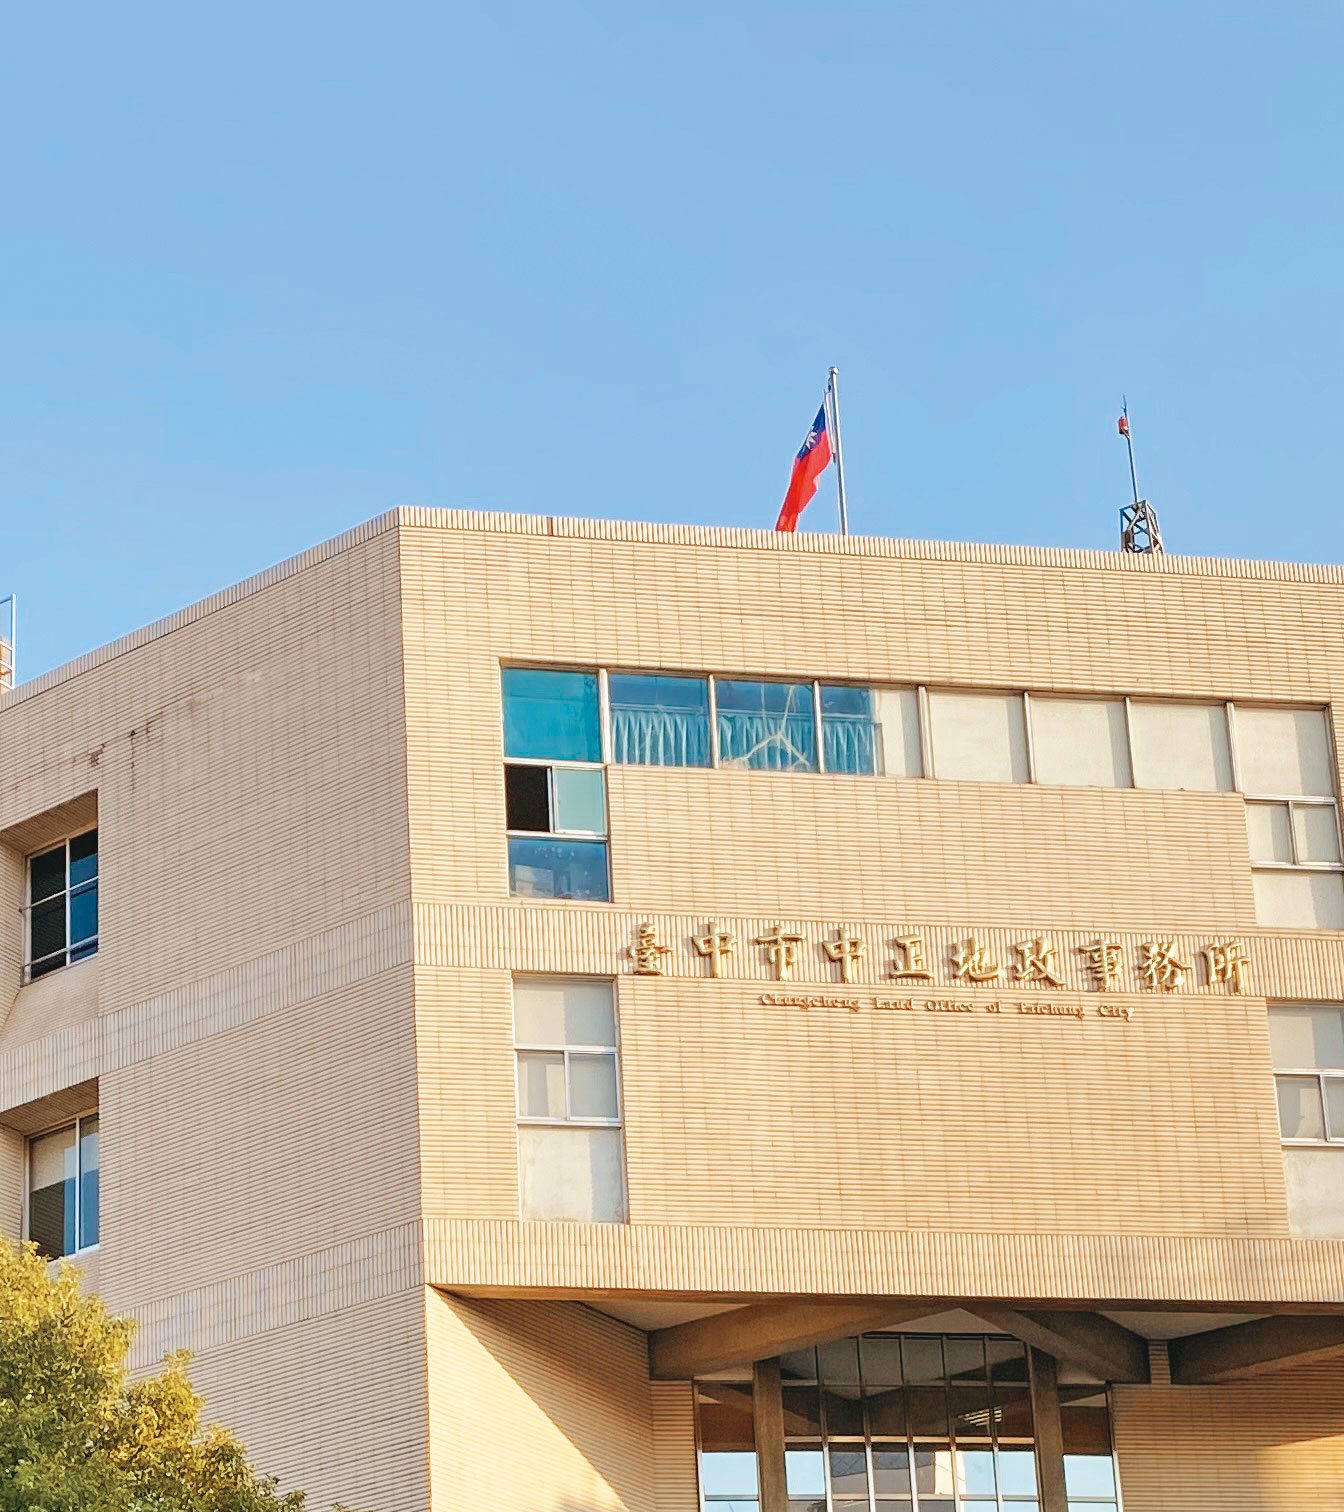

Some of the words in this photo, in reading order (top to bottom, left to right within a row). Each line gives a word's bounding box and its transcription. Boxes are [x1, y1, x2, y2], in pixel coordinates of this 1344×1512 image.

[626, 921, 1251, 994] 臺中市中正地政事務所
[873, 997, 915, 1011] Land
[924, 999, 973, 1013] Office
[985, 1000, 1002, 1014] of
[1015, 1001, 1085, 1020] Taichung
[1096, 1005, 1136, 1022] City
